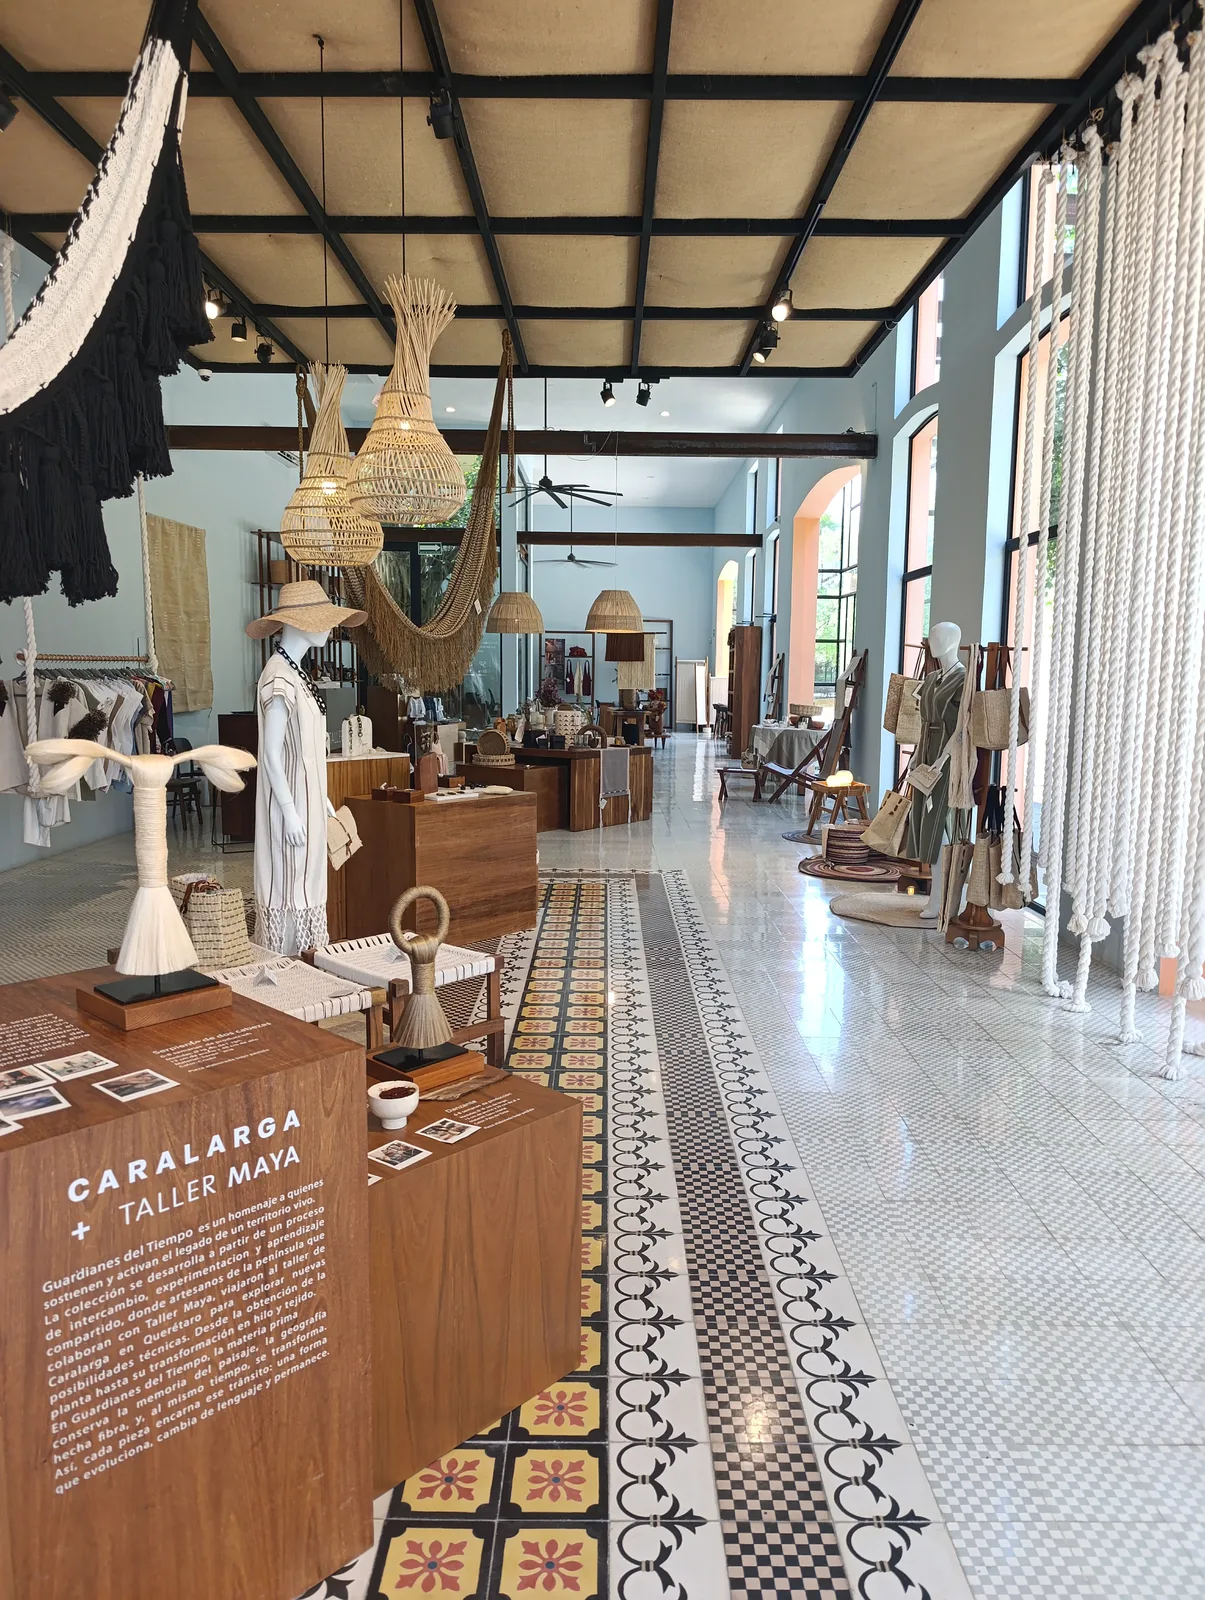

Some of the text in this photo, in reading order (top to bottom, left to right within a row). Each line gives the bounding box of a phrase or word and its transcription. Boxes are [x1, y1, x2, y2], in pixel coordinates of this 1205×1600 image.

[10, 1013, 53, 1024] serpiente
[36, 1018, 63, 1027] evoca
[67, 1109, 301, 1204] CARALARGA
[118, 1174, 217, 1226] TALLER
[227, 1145, 301, 1188] MAYA
[41, 1256, 120, 1292] Guardianes
[123, 1244, 143, 1261] del
[145, 1228, 193, 1252] Tiempo
[197, 1222, 209, 1232] es
[212, 1217, 225, 1227] un
[228, 1196, 277, 1221] homenaje
[287, 1178, 323, 1199] quienes
[43, 1280, 103, 1309] sostienen
[106, 1275, 113, 1286] y
[116, 1258, 158, 1280] activan
[161, 1250, 172, 1261] el
[175, 1236, 212, 1256] legado
[214, 1230, 228, 1240] de
[230, 1224, 244, 1234] un
[246, 1205, 291, 1228] territorio
[44, 1206, 324, 1325] La colección se desarrolla a partir de un proceso
[45, 1328, 61, 1340] de
[69, 1294, 148, 1330] intercambio,
[267, 1219, 324, 1248] aprendizaje
[46, 1232, 324, 1356] compartido, donde artesanos de la península que
[47, 1245, 325, 1371] colaboran con Taller Maya, viajaron al taller de
[48, 1258, 325, 1387] Caralarga en Querétaro para explorar nuevas
[49, 1271, 325, 1405] posibilidades técnicas. Desde la obtención de la
[50, 1291, 316, 1420] planta hasta su transformación en hilo y tejido.
[51, 1311, 297, 1433] En Guardianes del Tiempo, la materia prima
[52, 1416, 109, 1448] conserva
[117, 1407, 128, 1417] la
[136, 1379, 186, 1408] memoria
[194, 1364, 211, 1379] del
[265, 1336, 274, 1345] la
[280, 1310, 326, 1339] geografía
[53, 1440, 91, 1464] hecha
[150, 1403, 161, 1415] al
[167, 1384, 204, 1407] mismo
[209, 1363, 250, 1386] tiempo,
[255, 1353, 266, 1364] se
[271, 1325, 327, 1355] transforma.
[54, 1337, 327, 1479] Así, cada pieza encarna ese tránsito: una forma
[55, 1476, 79, 1494] que
[83, 1441, 153, 1479] evoluciona,
[156, 1416, 197, 1441] cambia
[200, 1408, 214, 1419] de
[217, 1383, 262, 1411] lenguaje
[274, 1350, 329, 1383] permanece.
